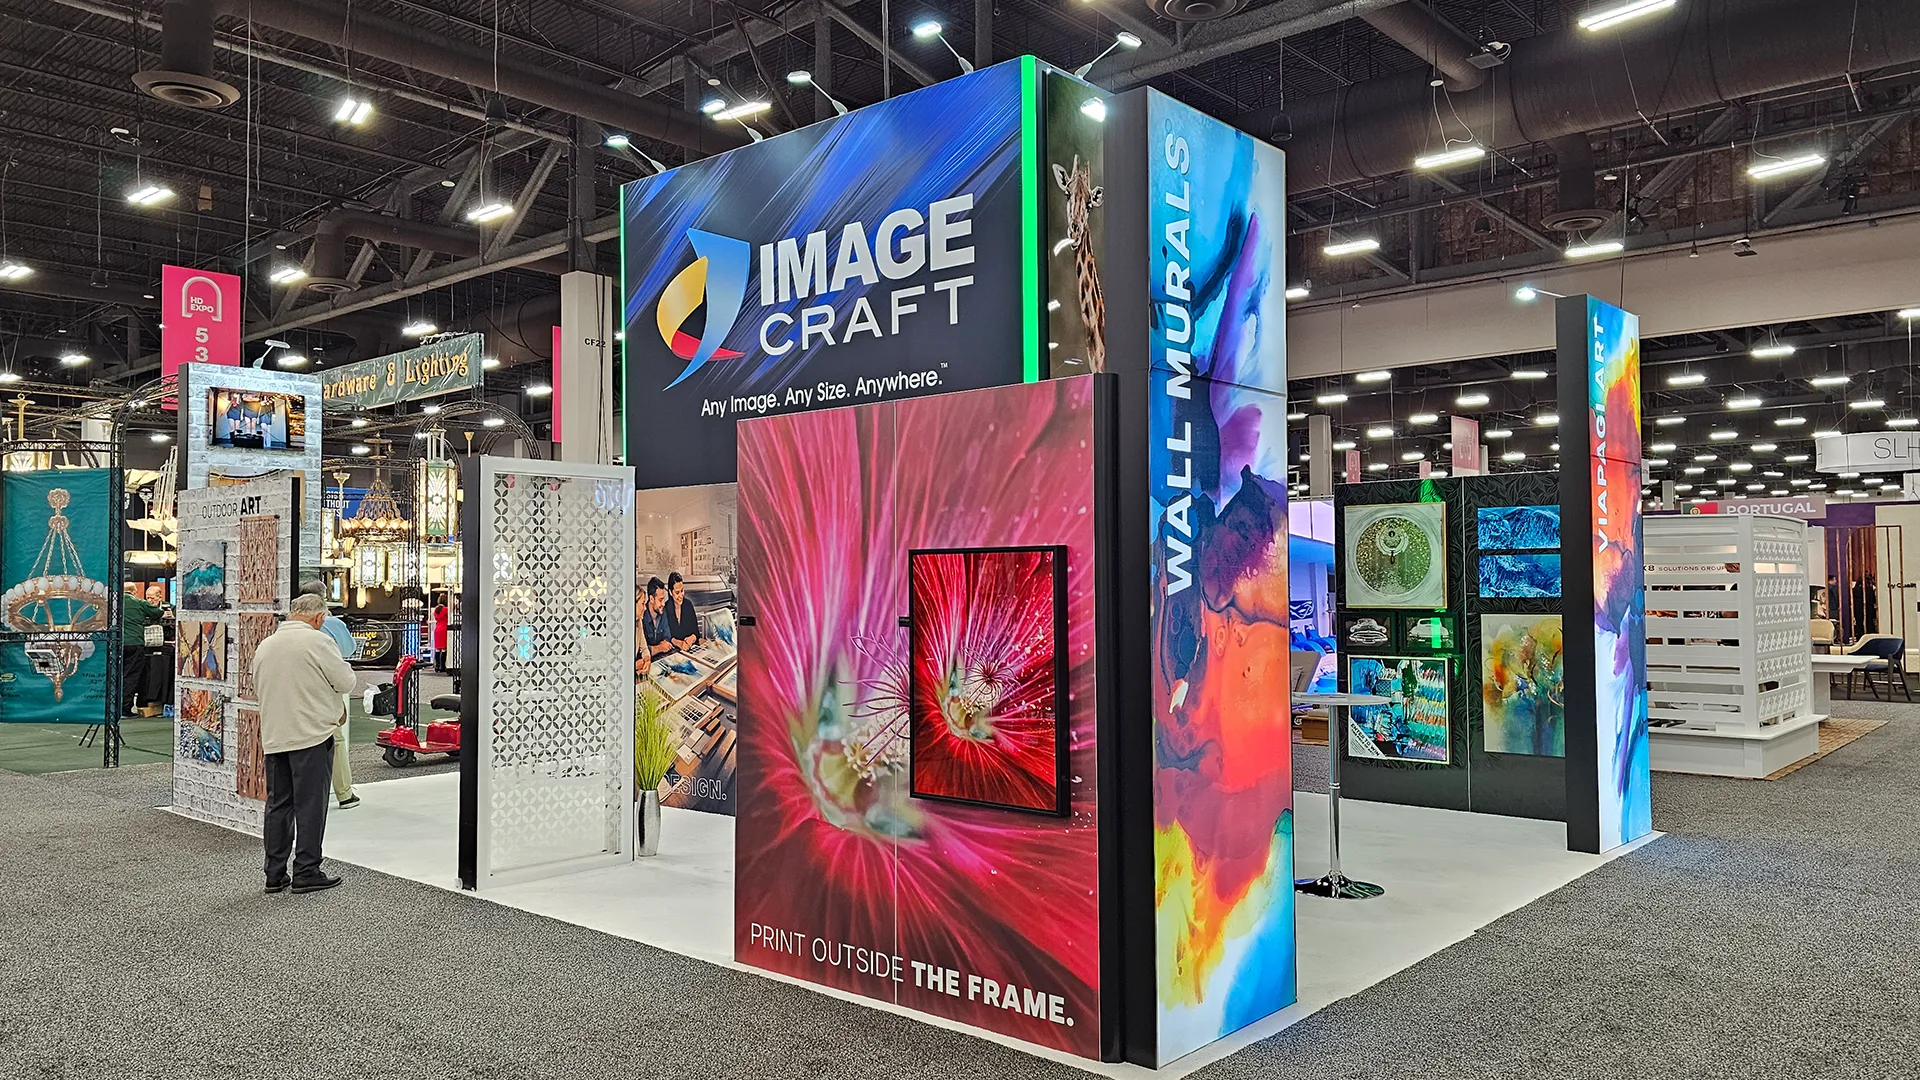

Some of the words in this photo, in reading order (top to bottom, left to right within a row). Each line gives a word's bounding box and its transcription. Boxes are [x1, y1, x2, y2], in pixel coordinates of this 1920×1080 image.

[760, 193, 975, 307] IMAGE
[1164, 132, 1193, 401] MURALS
[190, 296, 204, 305] HD
[190, 303, 214, 313] EXPO
[760, 275, 974, 356] CRAFT
[324, 373, 377, 400] ardware
[404, 350, 469, 385] Lighting
[1593, 316, 1605, 391] ART
[701, 398, 727, 418] Any
[730, 392, 781, 414] Image.
[784, 387, 813, 407] Any
[817, 381, 850, 402] Size.
[202, 502, 238, 519] OUTDOOR
[240, 496, 261, 515] ART
[1166, 421, 1193, 597] WALL
[1726, 502, 1816, 515] PORTUGAL
[751, 922, 805, 957] PRINT
[812, 937, 904, 983] OUTSIDE
[911, 960, 960, 997] THE
[968, 973, 1075, 1027] FRAME.
